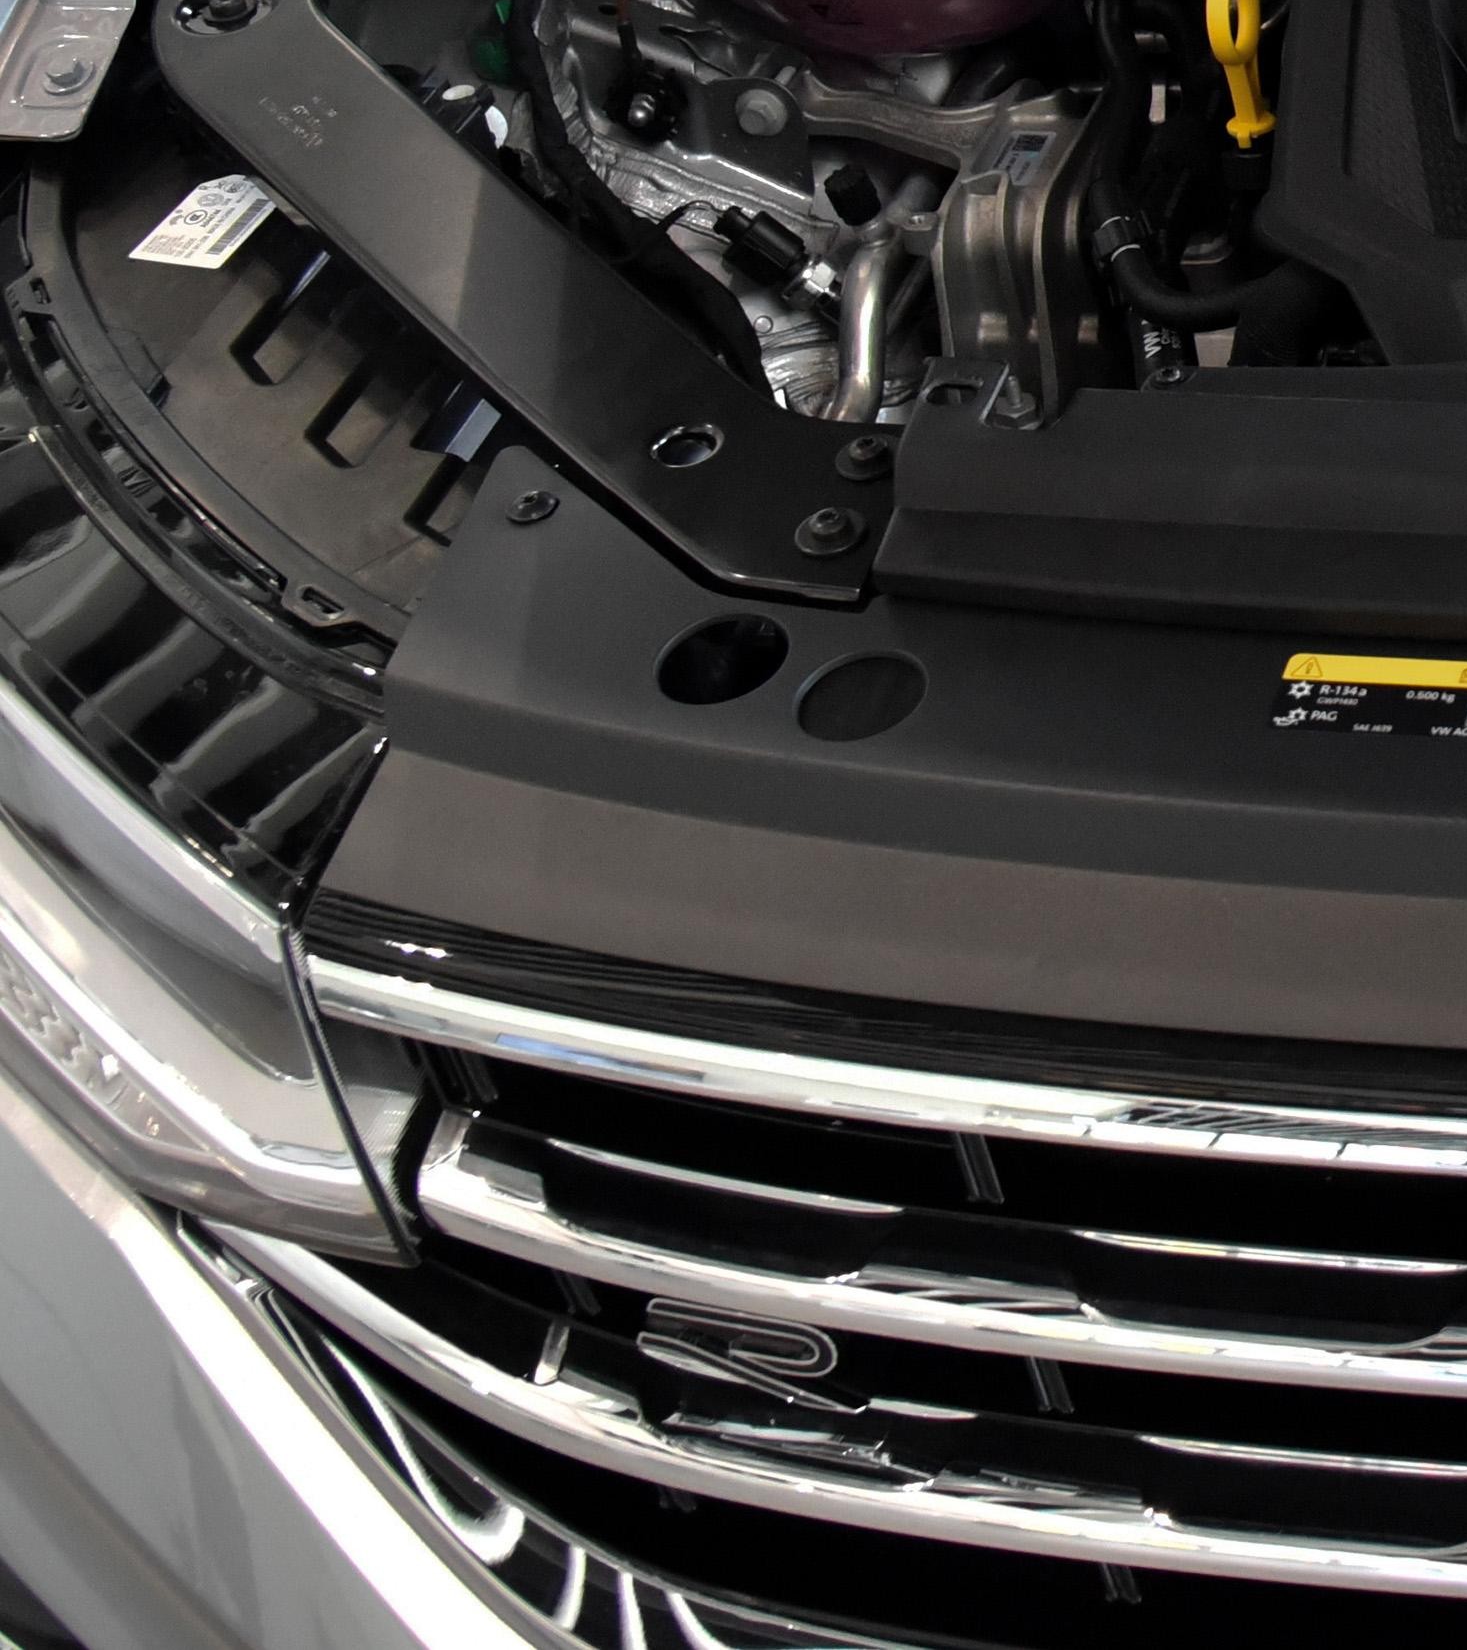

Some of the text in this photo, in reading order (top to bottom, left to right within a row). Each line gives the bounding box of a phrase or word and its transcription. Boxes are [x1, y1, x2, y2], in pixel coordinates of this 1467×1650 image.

[1440, 691, 1456, 704] kg
[1309, 710, 1339, 722] PAG
[1430, 726, 1452, 736] VW
